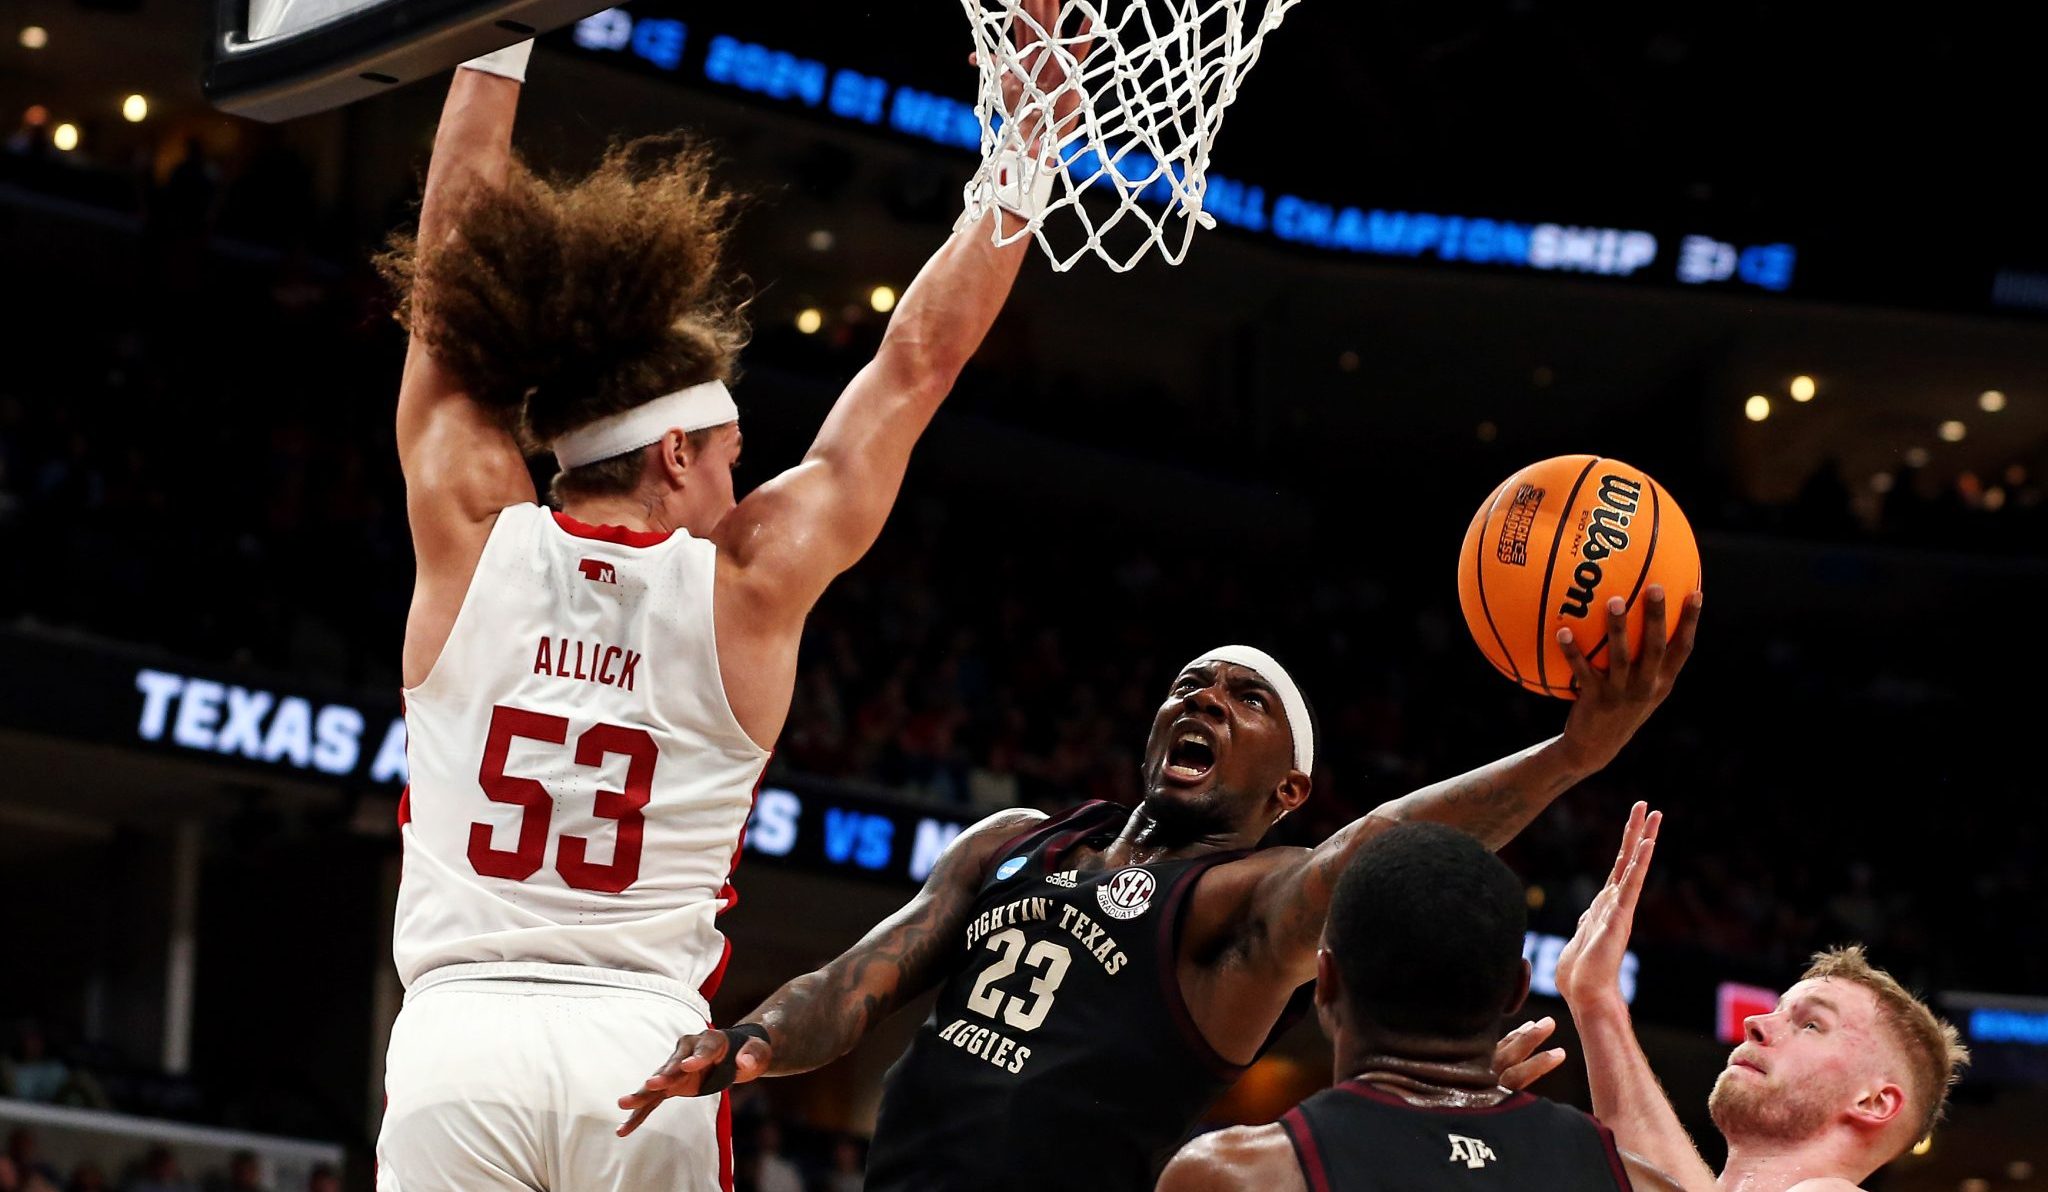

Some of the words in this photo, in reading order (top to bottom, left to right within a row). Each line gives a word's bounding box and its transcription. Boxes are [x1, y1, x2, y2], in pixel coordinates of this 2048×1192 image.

[1273, 194, 1657, 276] CHAMPIONSHIP
[1501, 503, 1524, 562] MADNESS
[1516, 500, 1538, 541] MARCH
[1559, 474, 1641, 619] Wilson
[1571, 534, 1582, 557] NXT
[533, 636, 641, 691] ALLICK
[136, 668, 366, 776] TEXAS
[824, 807, 895, 870] VS
[467, 705, 659, 894] 53
[1045, 875, 1078, 889] adidas
[1098, 894, 1140, 919] GRADUATE
[1111, 871, 1152, 907] SEC
[966, 897, 1053, 950] FIGHTIN'
[1059, 904, 1128, 976] TEXAS
[967, 927, 1072, 1032] 23
[939, 1019, 1031, 1074] AGGIES
